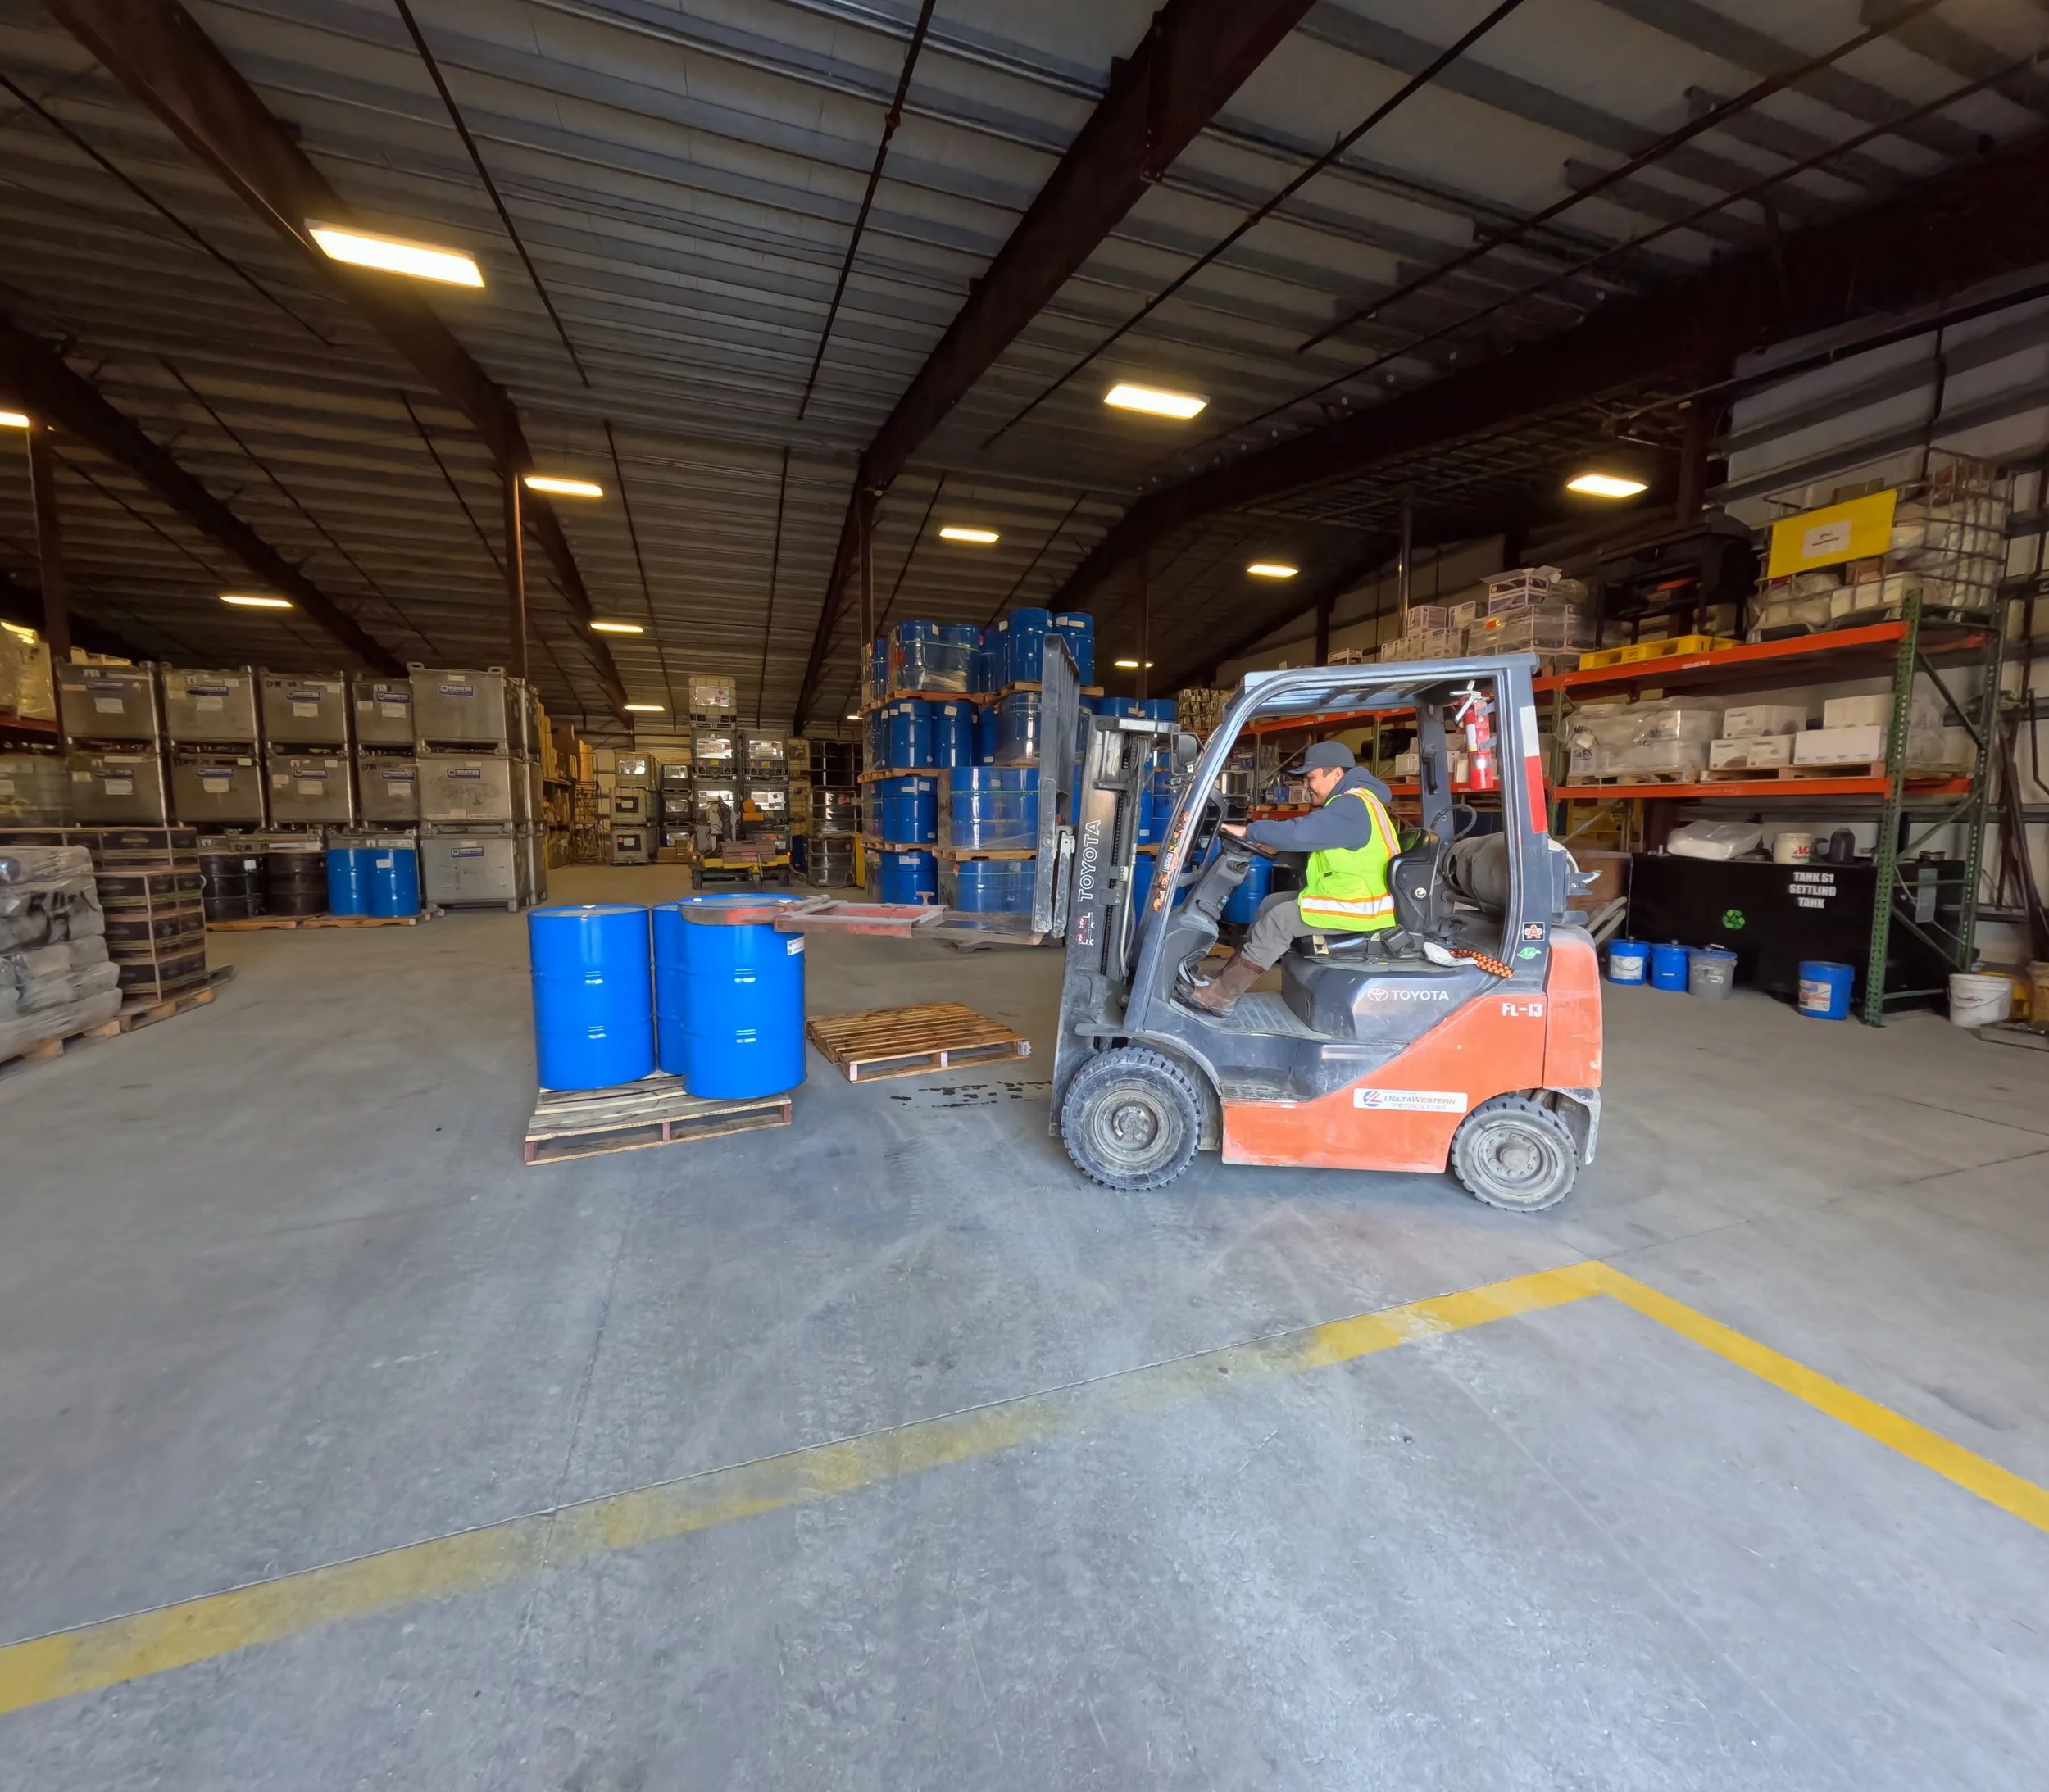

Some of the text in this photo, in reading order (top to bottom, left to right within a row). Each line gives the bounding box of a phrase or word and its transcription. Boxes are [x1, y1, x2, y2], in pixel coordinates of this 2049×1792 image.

[1078, 819, 1102, 902] TOYOTA
[1793, 872, 1835, 883] TANK S1
[1789, 884, 1837, 896] SETTLING
[1797, 897, 1825, 909] TANK
[1391, 990, 1449, 1000] TOYOTA
[1502, 1003, 1544, 1017] FL-13
